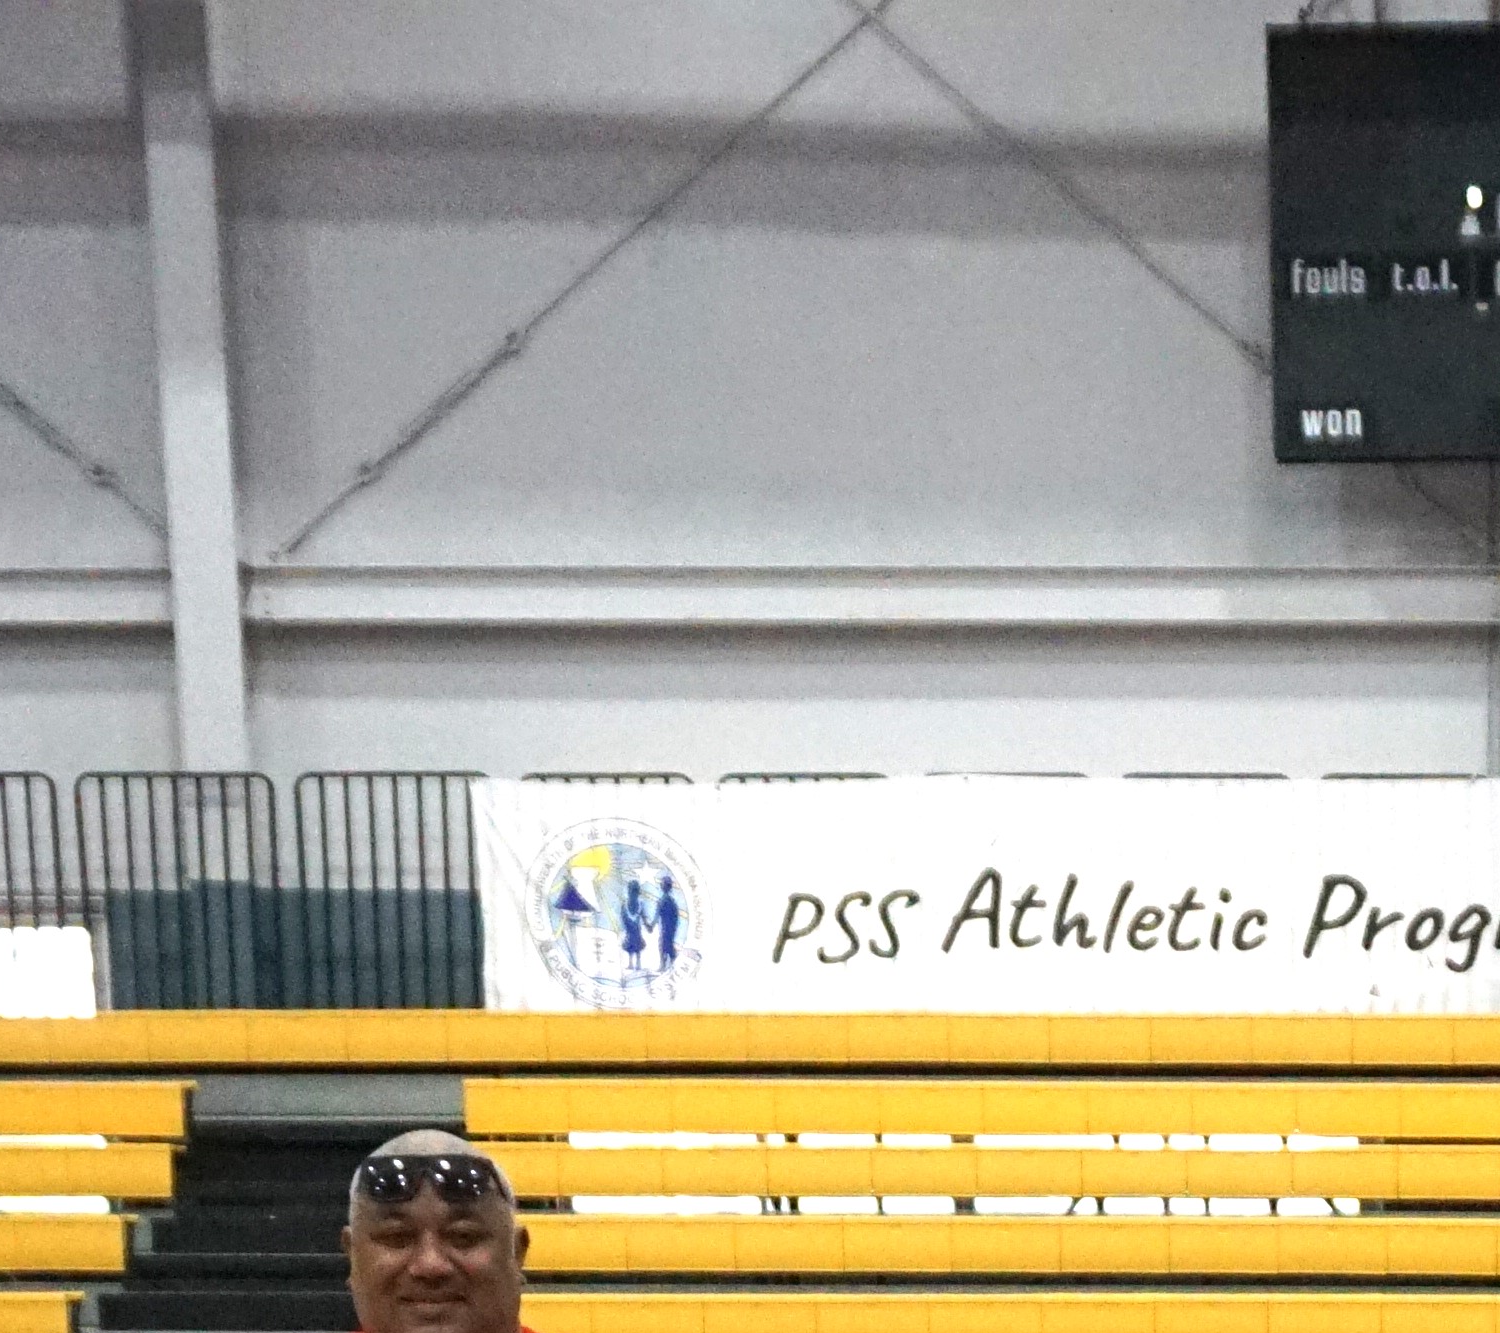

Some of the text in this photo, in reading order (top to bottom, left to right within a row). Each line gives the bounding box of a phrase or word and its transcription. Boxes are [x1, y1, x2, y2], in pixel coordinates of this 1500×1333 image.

[1291, 258, 1368, 294] fouls
[1301, 407, 1363, 437] won
[772, 888, 921, 964] PSS
[941, 866, 1269, 954] Athletic
